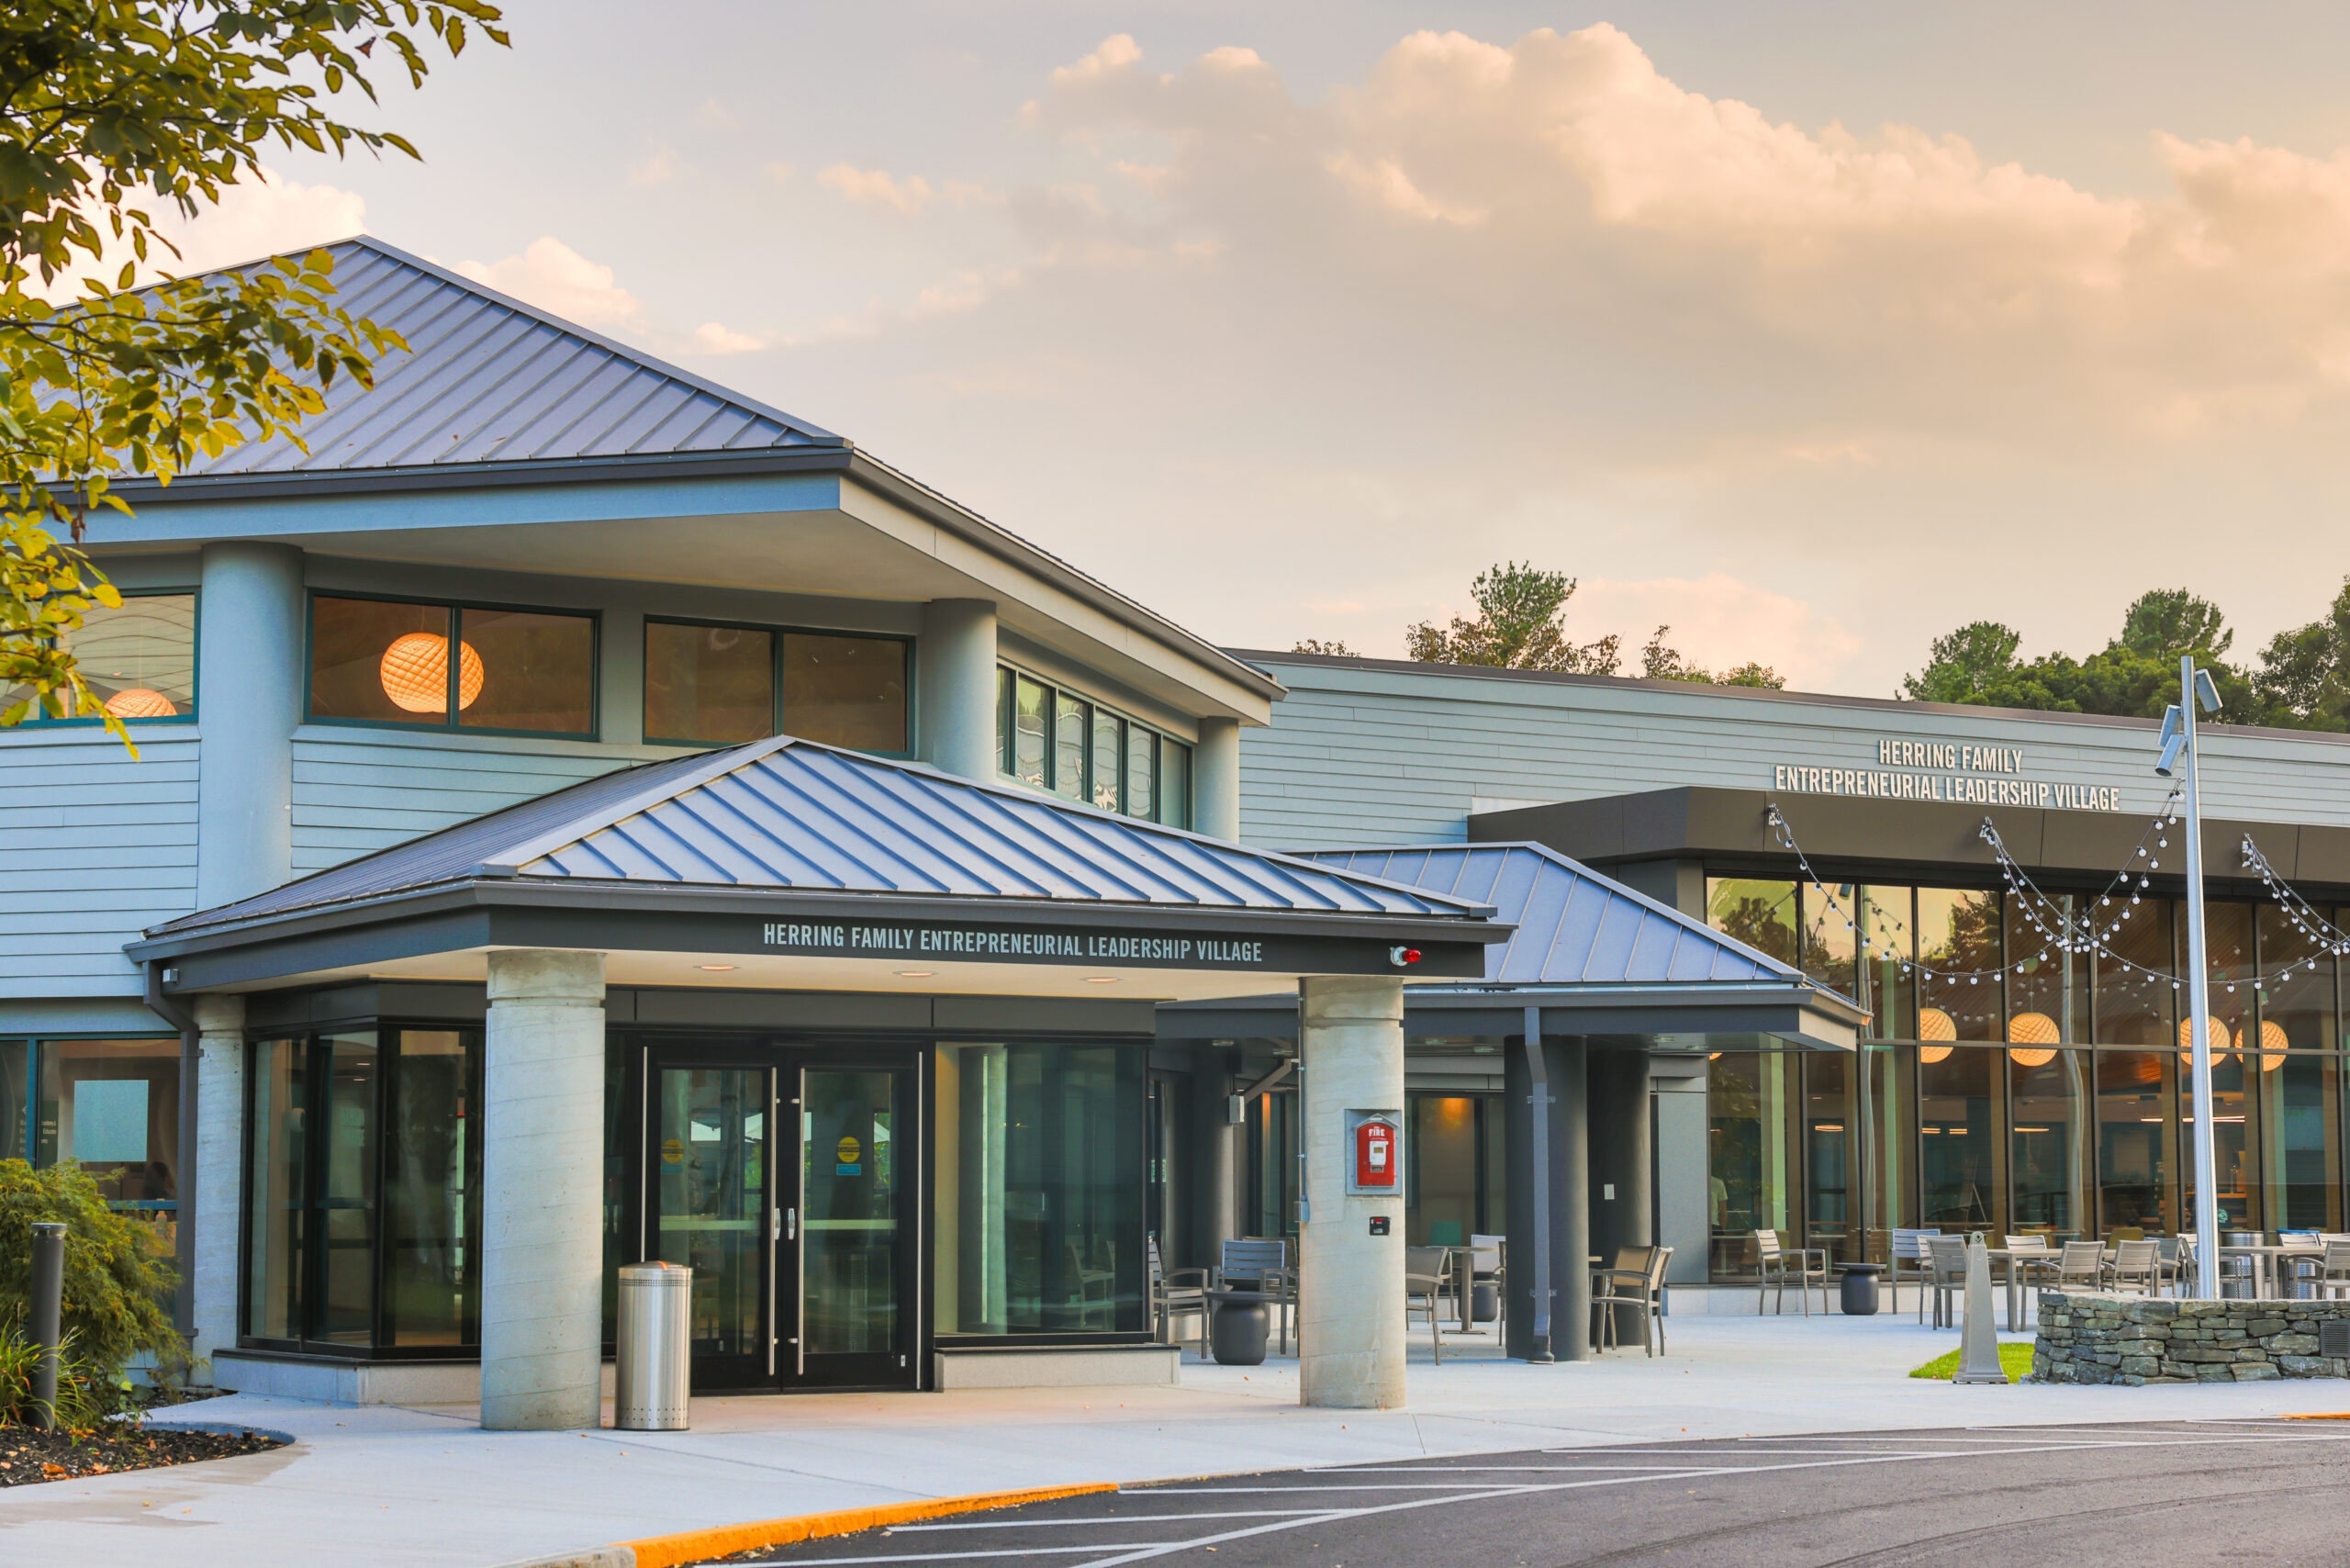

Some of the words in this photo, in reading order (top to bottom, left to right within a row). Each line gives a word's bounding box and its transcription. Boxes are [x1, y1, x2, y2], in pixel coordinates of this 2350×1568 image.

[1879, 740, 1956, 769] HERRING
[1961, 745, 2023, 773] FAMILY
[1775, 765, 1941, 801] ENTREPRENEURIAL
[1945, 777, 2049, 806] LEADERSHIP
[2054, 784, 2120, 812] VILLAGE
[764, 924, 844, 946] HERRING
[851, 927, 913, 949] FAMILY
[920, 930, 1083, 957] ENTREPRENEURIAL
[1088, 935, 1191, 959] LEADERSHIP
[1196, 940, 1262, 962] VILLAGE
[1368, 1128, 1385, 1137] FIRE
